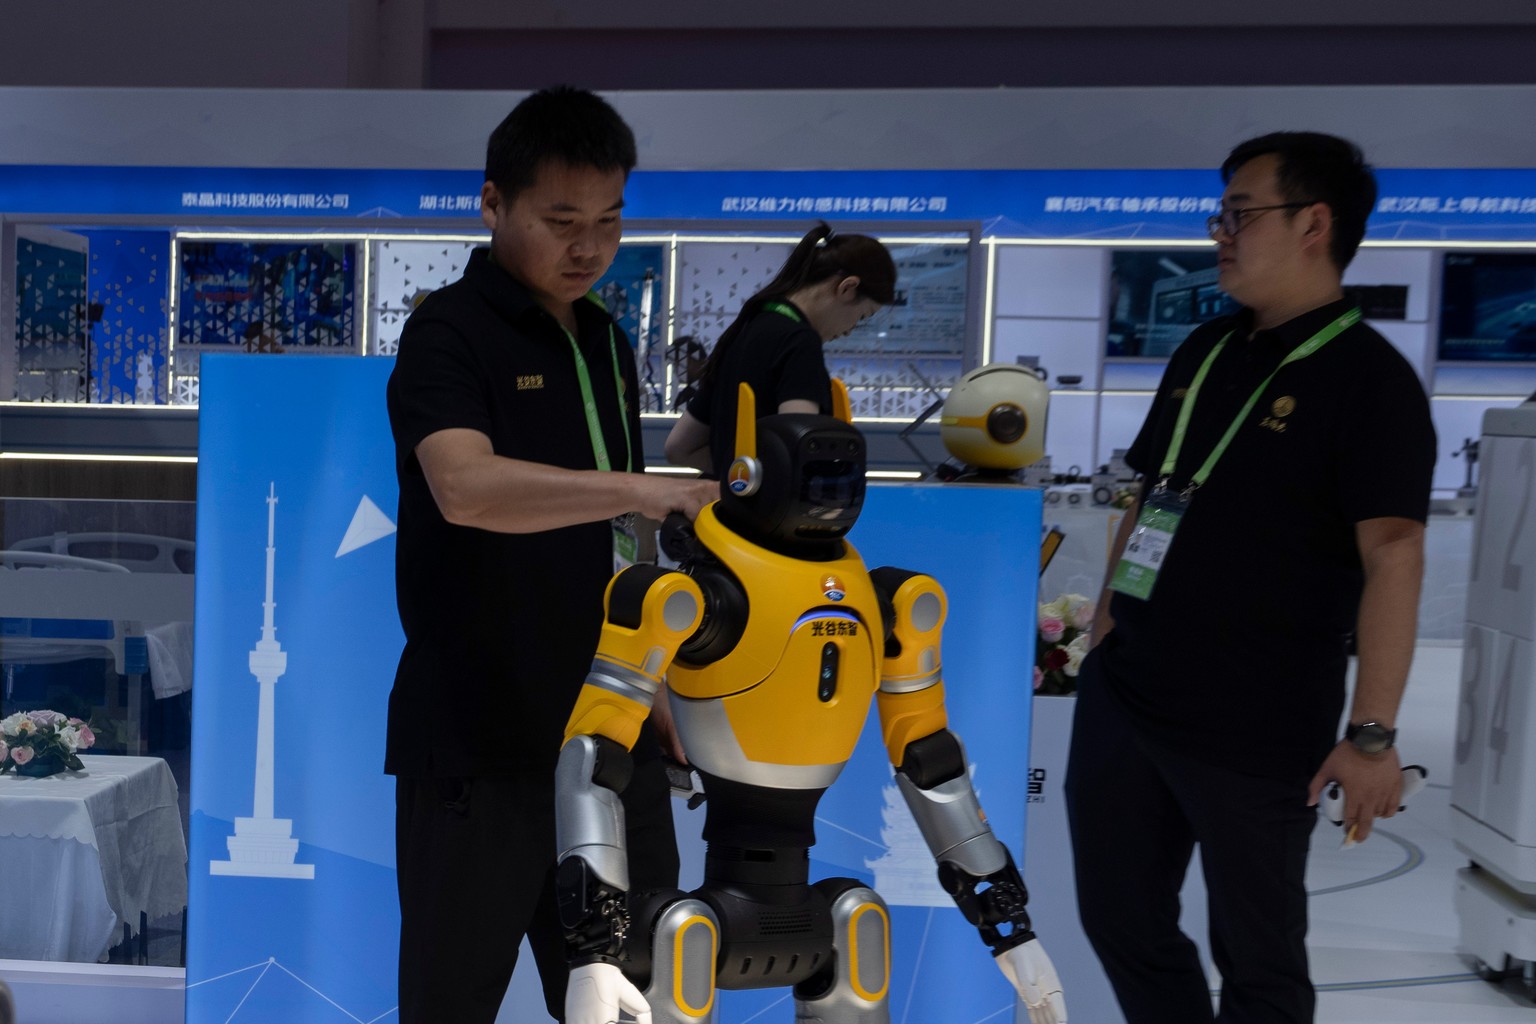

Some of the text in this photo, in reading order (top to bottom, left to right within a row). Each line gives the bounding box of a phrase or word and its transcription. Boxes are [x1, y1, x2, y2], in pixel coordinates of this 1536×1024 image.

[182, 192, 349, 209] 泰晶科技股份有限公司
[811, 621, 858, 637] 光谷东智
